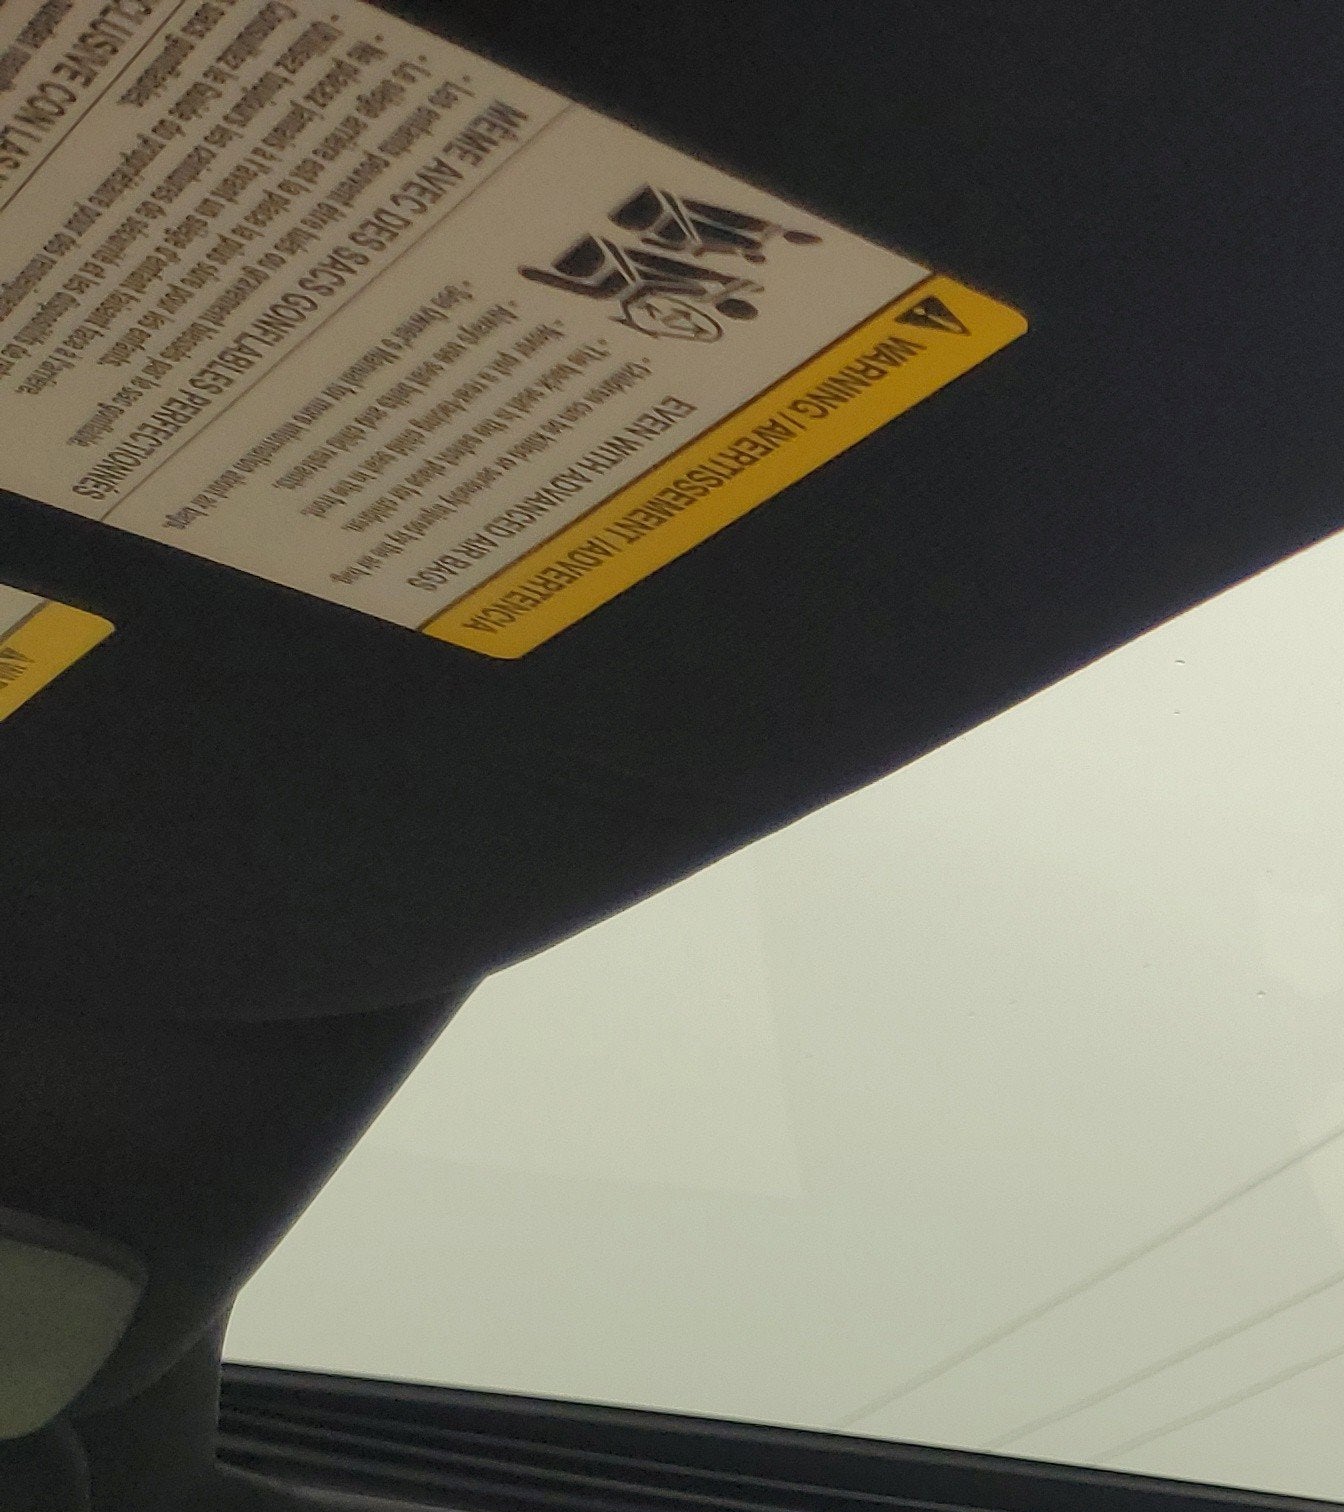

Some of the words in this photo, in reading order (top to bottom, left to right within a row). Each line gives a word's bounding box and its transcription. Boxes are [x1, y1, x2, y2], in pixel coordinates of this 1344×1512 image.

[13, 81, 78, 131] CON
[441, 100, 529, 167] MÊME
[389, 156, 464, 215] AVEC
[347, 207, 413, 252] DES
[297, 245, 371, 297] SACS
[187, 292, 319, 395] GONFLABLES
[787, 335, 927, 420] WARNING
[71, 388, 212, 501] PERFECTIONNÉS
[623, 395, 698, 442] EVEN
[574, 435, 644, 475] WITH
[483, 466, 593, 539] ADVANCED
[450, 532, 500, 560] AIR
[406, 554, 473, 592] BAGS
